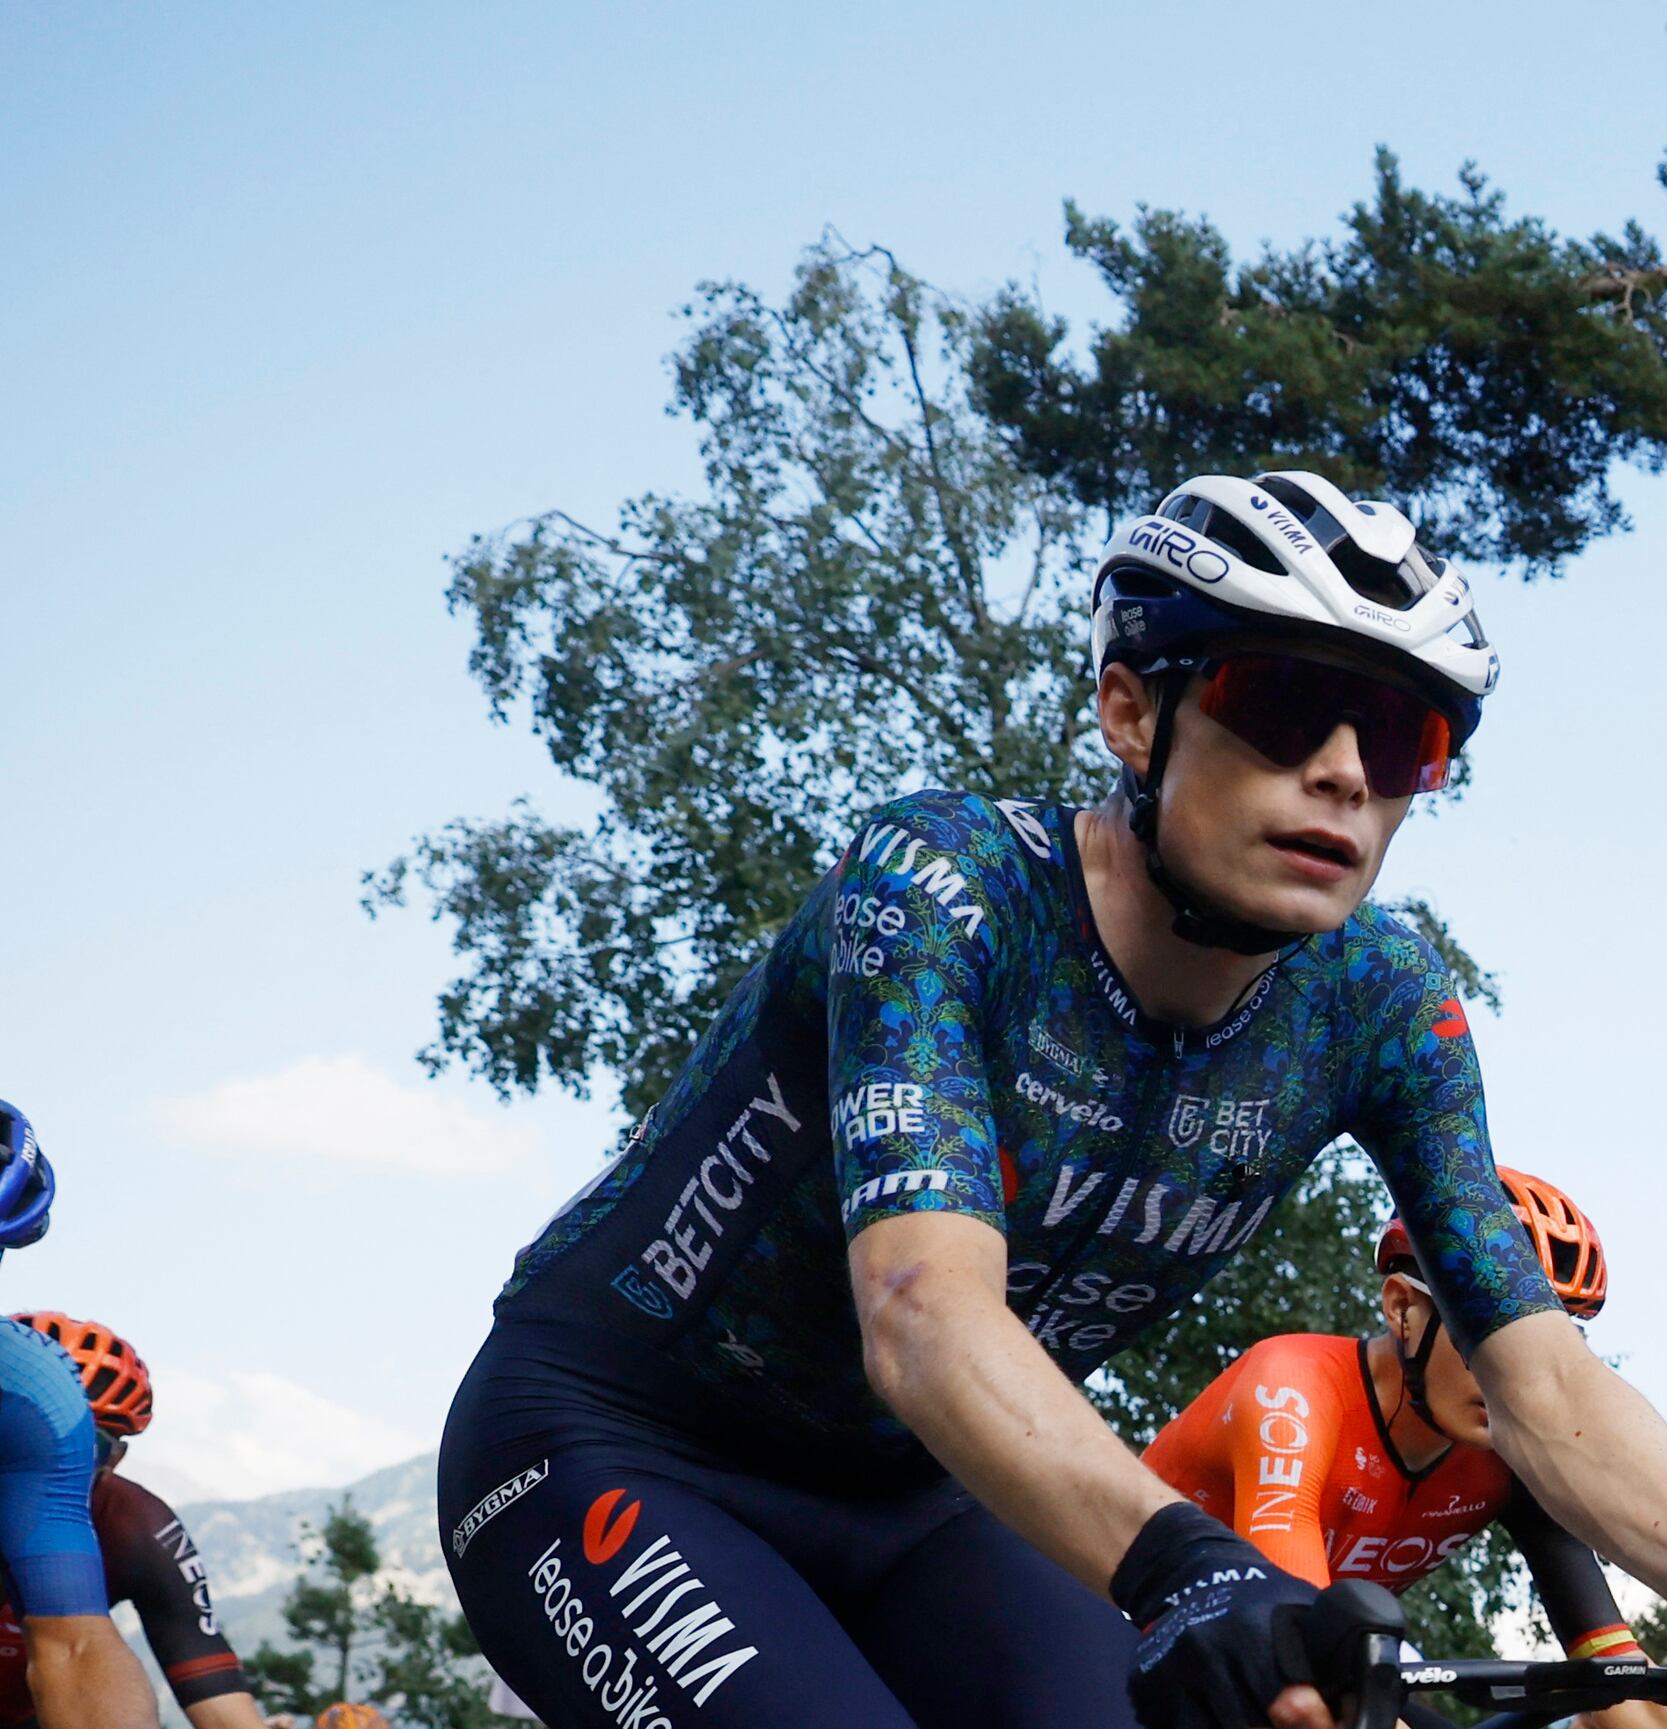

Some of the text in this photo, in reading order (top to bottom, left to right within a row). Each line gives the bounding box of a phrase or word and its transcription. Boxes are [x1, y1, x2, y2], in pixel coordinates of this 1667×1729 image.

[1129, 521, 1230, 585] GIRO
[1267, 510, 1313, 556] VISMA
[1354, 604, 1411, 633] GIRO
[859, 824, 984, 939] VISMA
[1090, 949, 1138, 1028] VISMA
[1205, 1010, 1252, 1050] lease
[1014, 1071, 1125, 1133] cervélo
[1216, 1099, 1270, 1128] BET
[1209, 1129, 1272, 1158] CITY
[642, 1073, 802, 1301] BETCITY
[1041, 1164, 1275, 1256] VISMA
[1249, 1384, 1311, 1535] INEOS
[462, 1464, 544, 1538] BYGMA
[155, 1519, 221, 1637] INEOS
[609, 1535, 759, 1708] VISMA
[1604, 1663, 1647, 1678] GARMIN
